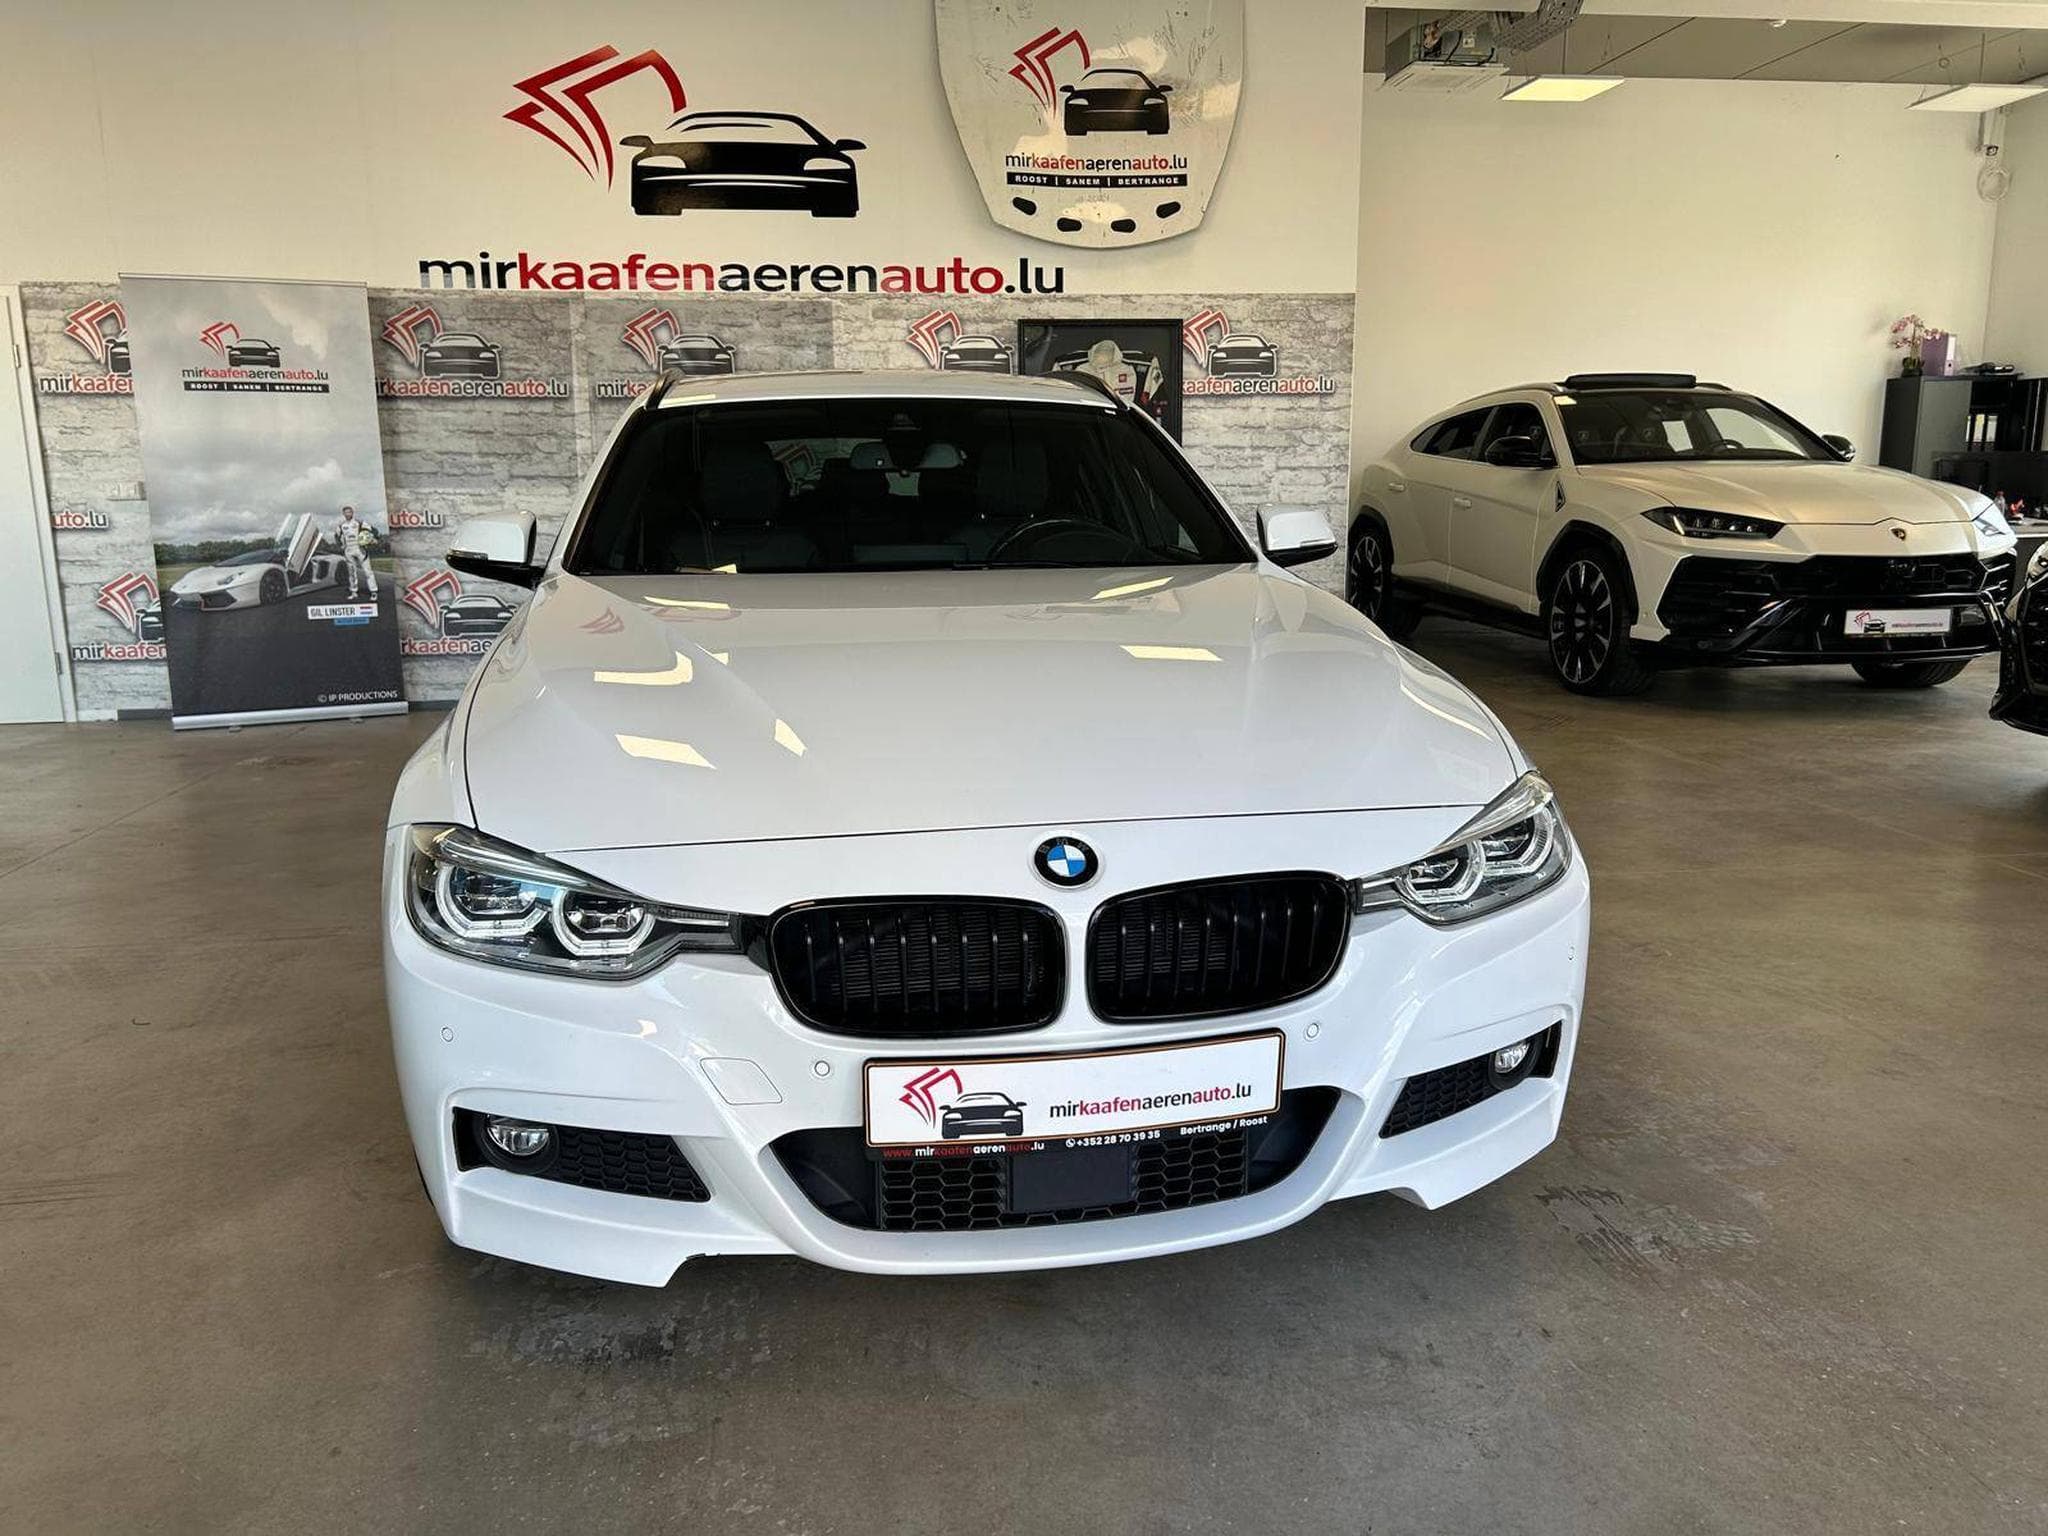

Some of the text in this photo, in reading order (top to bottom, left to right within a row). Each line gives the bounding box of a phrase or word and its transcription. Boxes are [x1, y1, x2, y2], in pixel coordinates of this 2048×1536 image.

[1005, 153, 1187, 171] mirkaafenaerenauto.lu
[1015, 175, 1180, 185] ROOST SANEM BERTRANGE
[419, 251, 1064, 293] mirkaafenaerenauto.lu
[182, 367, 328, 380] mirkaafenaerenauto.lu
[310, 607, 355, 617] GIL LINSTER
[338, 689, 398, 701] PRODUCTIONS
[1049, 1083, 1251, 1118] mirkaafenaerenauto.lu
[1180, 1122, 1232, 1136] Bertrange
[1239, 1115, 1267, 1127] Roost
[1077, 1136, 1102, 1147] +352
[1104, 1135, 1117, 1145] 28
[1119, 1134, 1130, 1143] 70
[1147, 1130, 1160, 1140] 35
